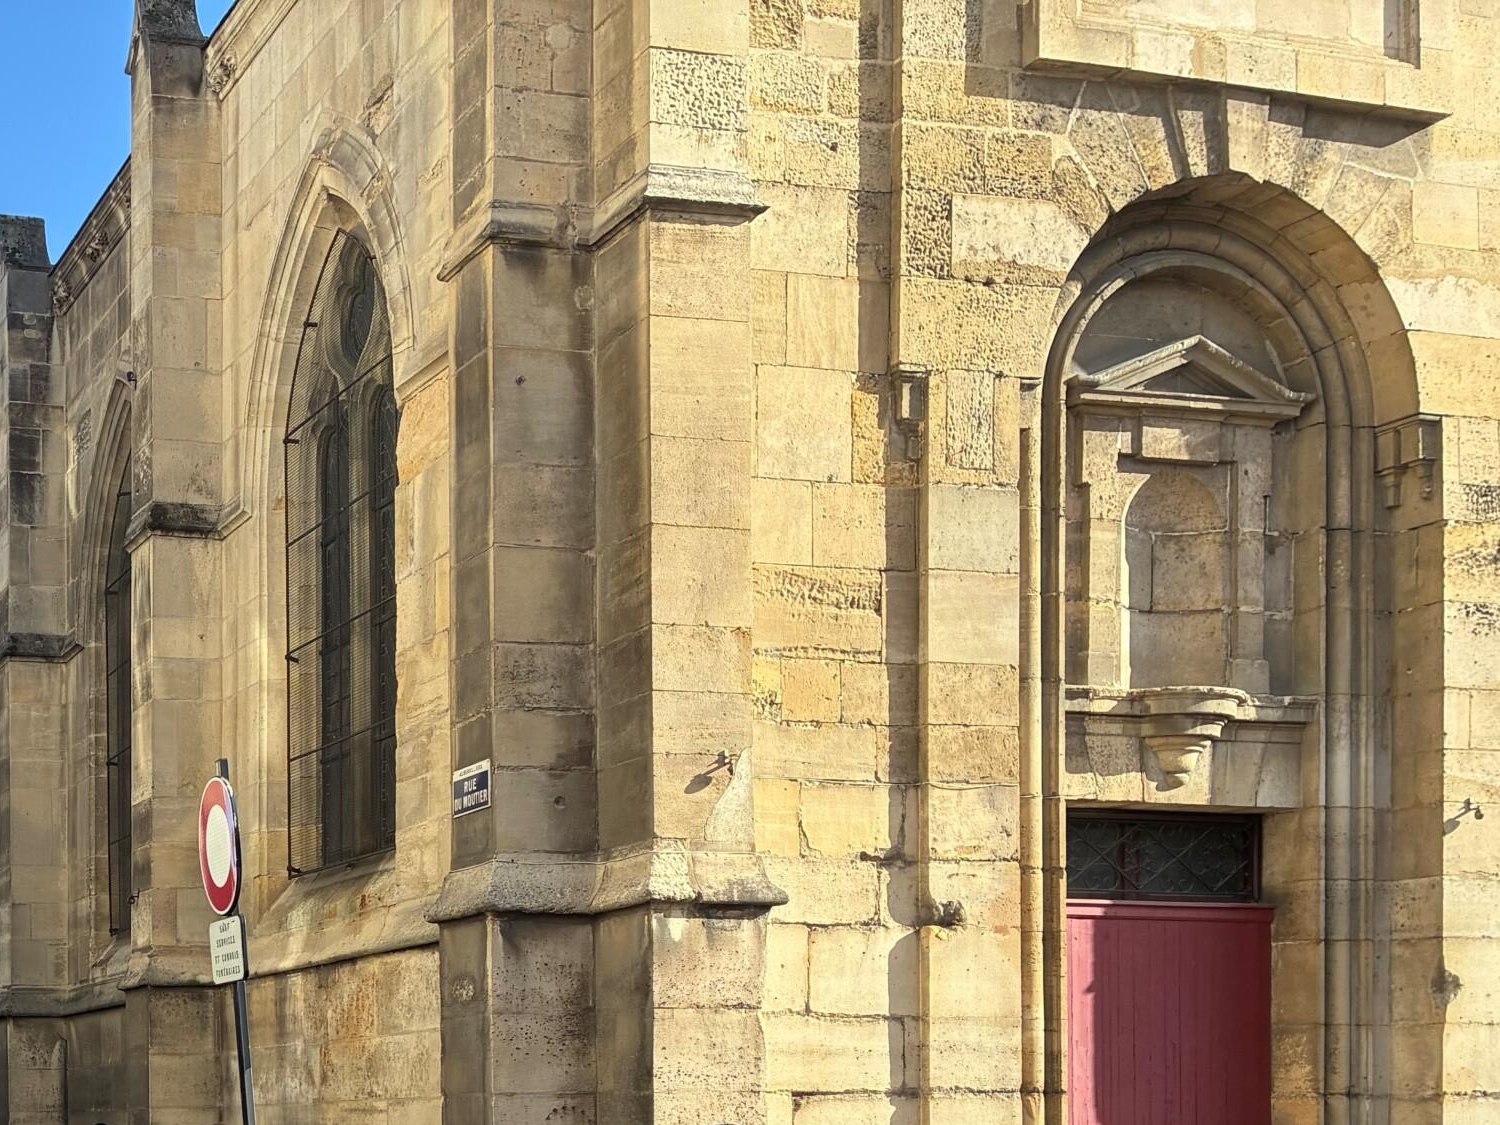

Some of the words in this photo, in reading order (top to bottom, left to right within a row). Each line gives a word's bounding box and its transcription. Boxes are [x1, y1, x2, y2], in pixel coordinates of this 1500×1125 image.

[464, 778, 477, 794] RUE
[455, 797, 463, 811] DU
[463, 789, 488, 808] MOUTIER
